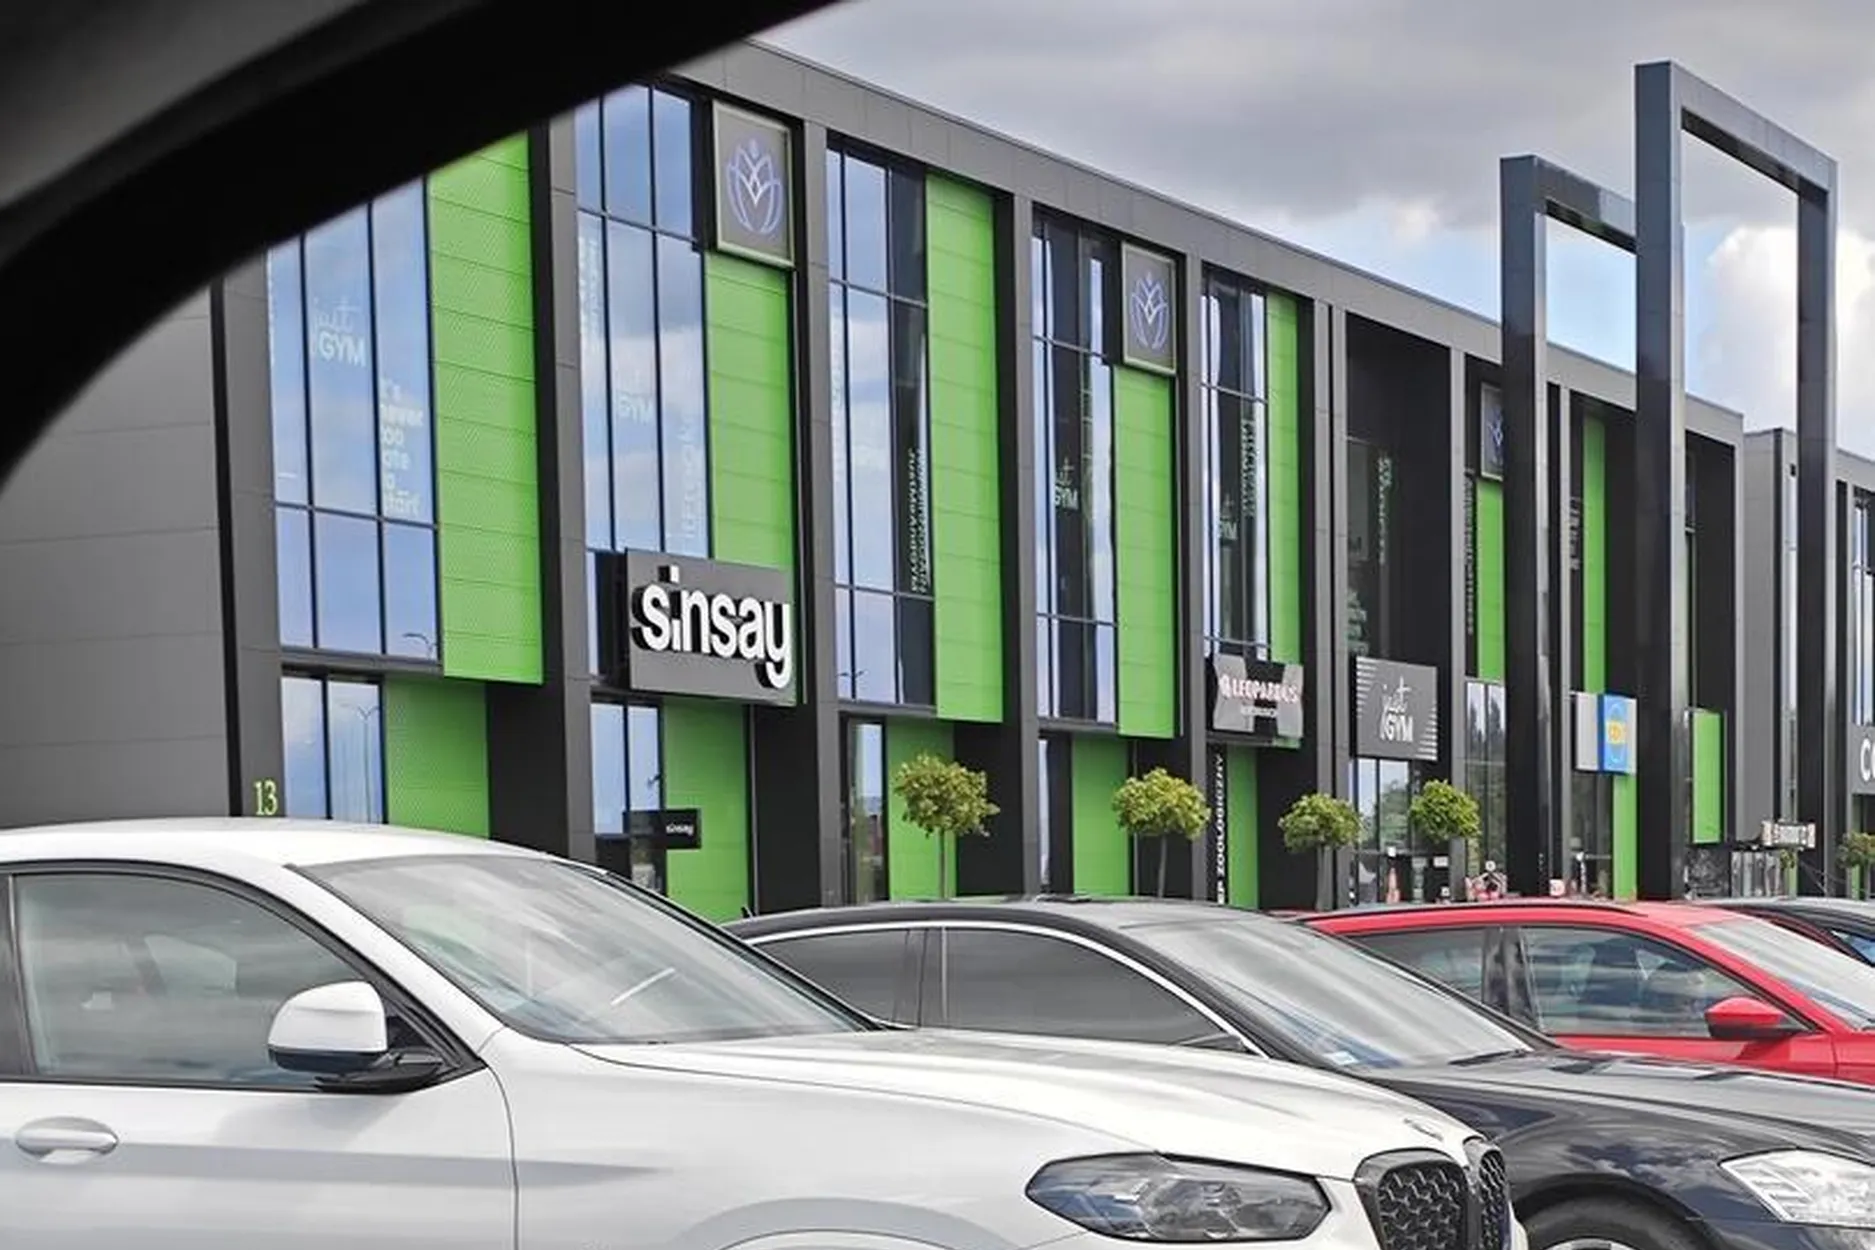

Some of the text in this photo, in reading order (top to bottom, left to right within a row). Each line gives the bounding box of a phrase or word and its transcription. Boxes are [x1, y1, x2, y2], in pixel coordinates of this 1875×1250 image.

[318, 331, 366, 367] GYM
[642, 565, 793, 689] sinsay
[1385, 713, 1414, 742] GYM
[1860, 738, 1875, 782] C
[254, 780, 278, 816] 13
